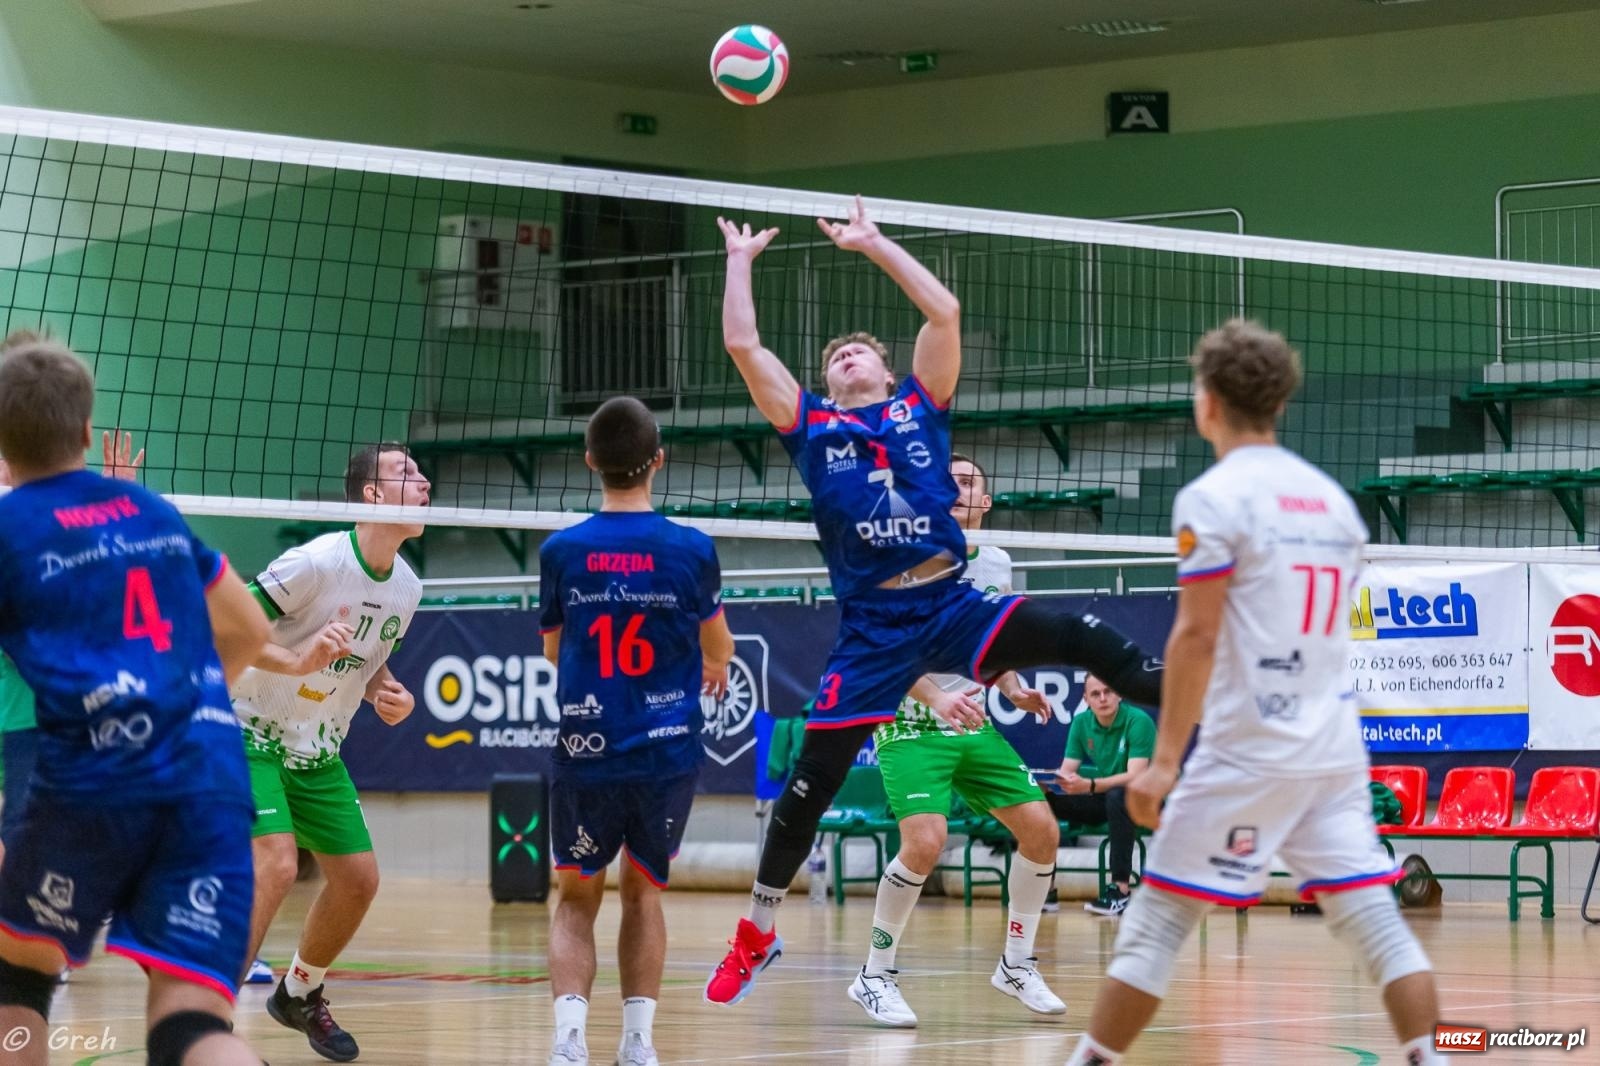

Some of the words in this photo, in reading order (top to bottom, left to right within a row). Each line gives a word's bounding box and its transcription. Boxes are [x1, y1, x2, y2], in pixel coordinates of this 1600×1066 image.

[1121, 105, 1160, 128] A
[827, 458, 857, 469] HOTELS
[587, 552, 654, 577] GRZĘDA
[568, 581, 611, 607] Dworek
[1292, 565, 1341, 636] 77
[123, 567, 172, 652] 4
[353, 614, 373, 641] 11
[588, 614, 654, 678] 16
[1371, 656, 1394, 671] 632
[1398, 656, 1425, 670] 695,
[1432, 654, 1457, 668] 606
[1461, 653, 1485, 668] 363
[1489, 652, 1513, 666] 647
[424, 655, 561, 722] OSiR
[816, 673, 842, 710] 3
[1367, 678, 1376, 692] J.
[1381, 681, 1405, 692] von
[1409, 674, 1493, 692] Eichendorffa
[1497, 675, 1505, 689] 2
[479, 723, 560, 747] RACIBÓRZ
[1361, 724, 1442, 744] tal-tech.pl
[1010, 921, 1023, 935] R
[294, 965, 310, 980] R
